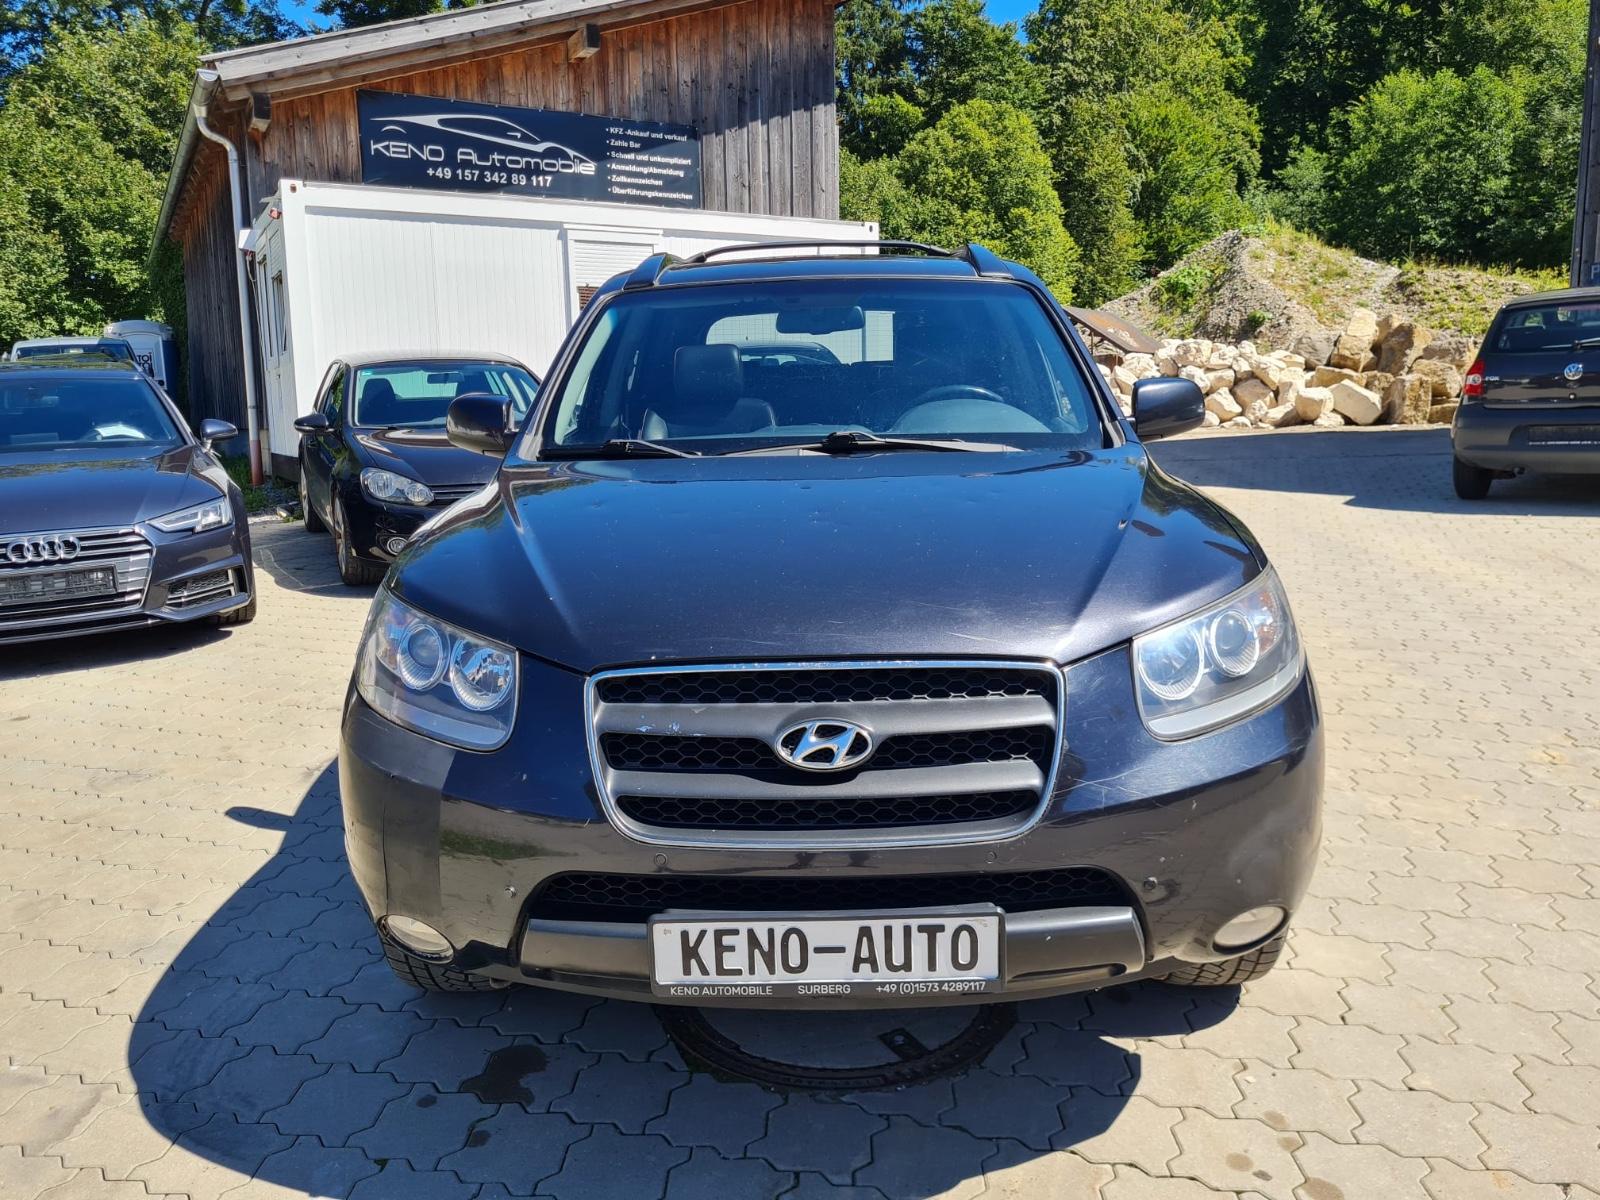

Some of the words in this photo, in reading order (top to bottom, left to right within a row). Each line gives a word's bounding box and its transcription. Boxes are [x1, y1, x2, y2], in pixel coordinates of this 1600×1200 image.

[610, 127, 624, 135] KFZ
[371, 140, 445, 162] KENO
[457, 148, 597, 175] Automobile
[611, 151, 635, 160] Schnell
[650, 155, 692, 165] unkompliziert
[427, 167, 451, 180] +49
[456, 169, 479, 182] 157
[484, 171, 507, 184] 342
[512, 173, 526, 186] 89
[531, 175, 552, 188] 117
[612, 186, 693, 200] Überführungskennzeichen
[670, 985, 700, 996] KENO
[702, 984, 773, 996] AUTOMOBILE
[798, 984, 851, 995] SURBERG
[876, 983, 897, 993] +49
[899, 982, 940, 994] (0)1573
[942, 981, 986, 992] 4289117
